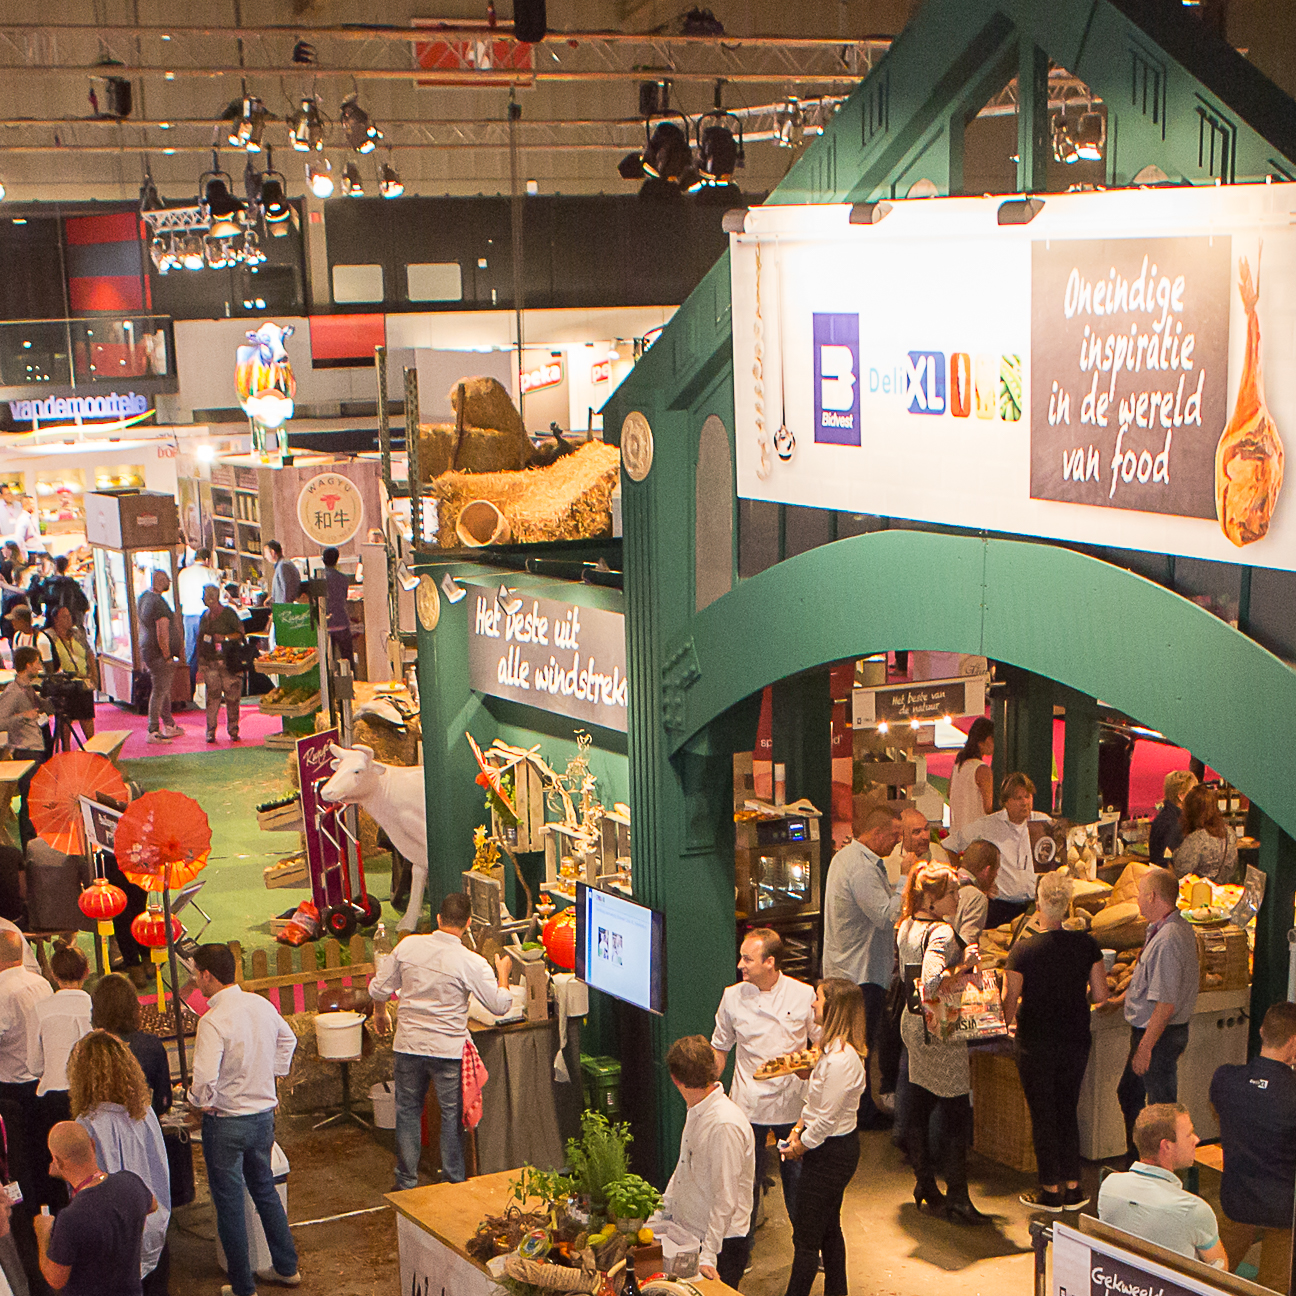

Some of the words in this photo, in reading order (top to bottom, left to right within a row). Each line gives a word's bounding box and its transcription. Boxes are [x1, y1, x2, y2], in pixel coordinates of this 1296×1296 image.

[1063, 256, 1186, 330] Oneindige
[1079, 315, 1196, 400] inspiratie
[521, 364, 561, 391] peka
[592, 364, 609, 383] pe
[9, 391, 148, 421] vandemoortele
[1049, 379, 1072, 427] in
[1080, 369, 1110, 429] de
[1118, 368, 1205, 430] wereld
[821, 411, 854, 429] Bidvest
[1062, 444, 1101, 483] van
[1108, 423, 1172, 499] food
[307, 477, 352, 495] WAGYU
[314, 509, 350, 531] 和牛
[475, 595, 501, 638] Het
[553, 605, 581, 650] uit
[497, 645, 530, 690] alle
[891, 695, 905, 706] Het
[907, 692, 928, 704] beste
[931, 691, 946, 700] van
[899, 704, 910, 715] de
[912, 702, 940, 713] natuur
